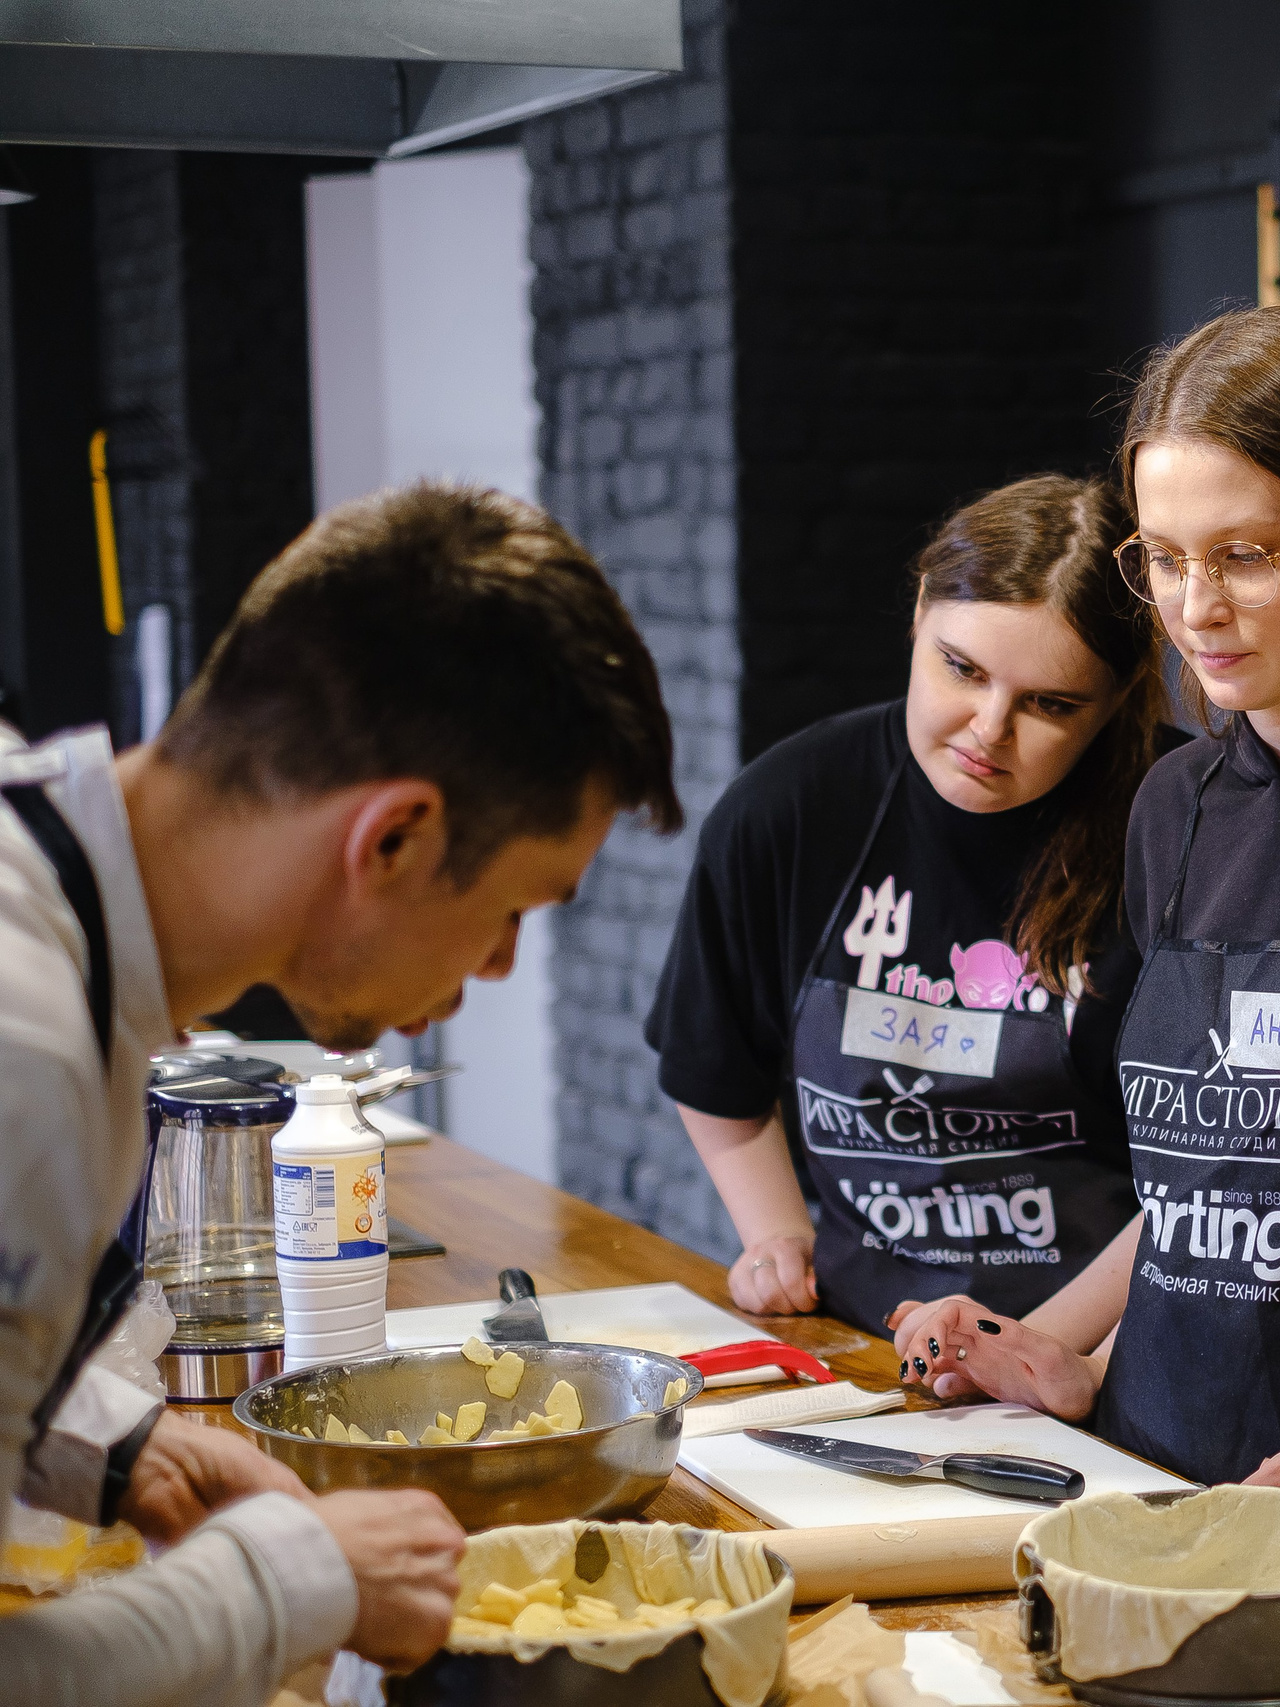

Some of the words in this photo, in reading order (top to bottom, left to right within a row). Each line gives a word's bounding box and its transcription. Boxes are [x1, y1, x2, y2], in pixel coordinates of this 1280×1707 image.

[870, 1006, 948, 1054] ЗАЯ
[803, 1090, 883, 1142] ИГРА
[1123, 1073, 1188, 1125] ИГРА
[1132, 1123, 1225, 1150] КУЛИНАРНАЯ
[1000, 1172, 1035, 1191] 1889
[1223, 1187, 1254, 1204] since
